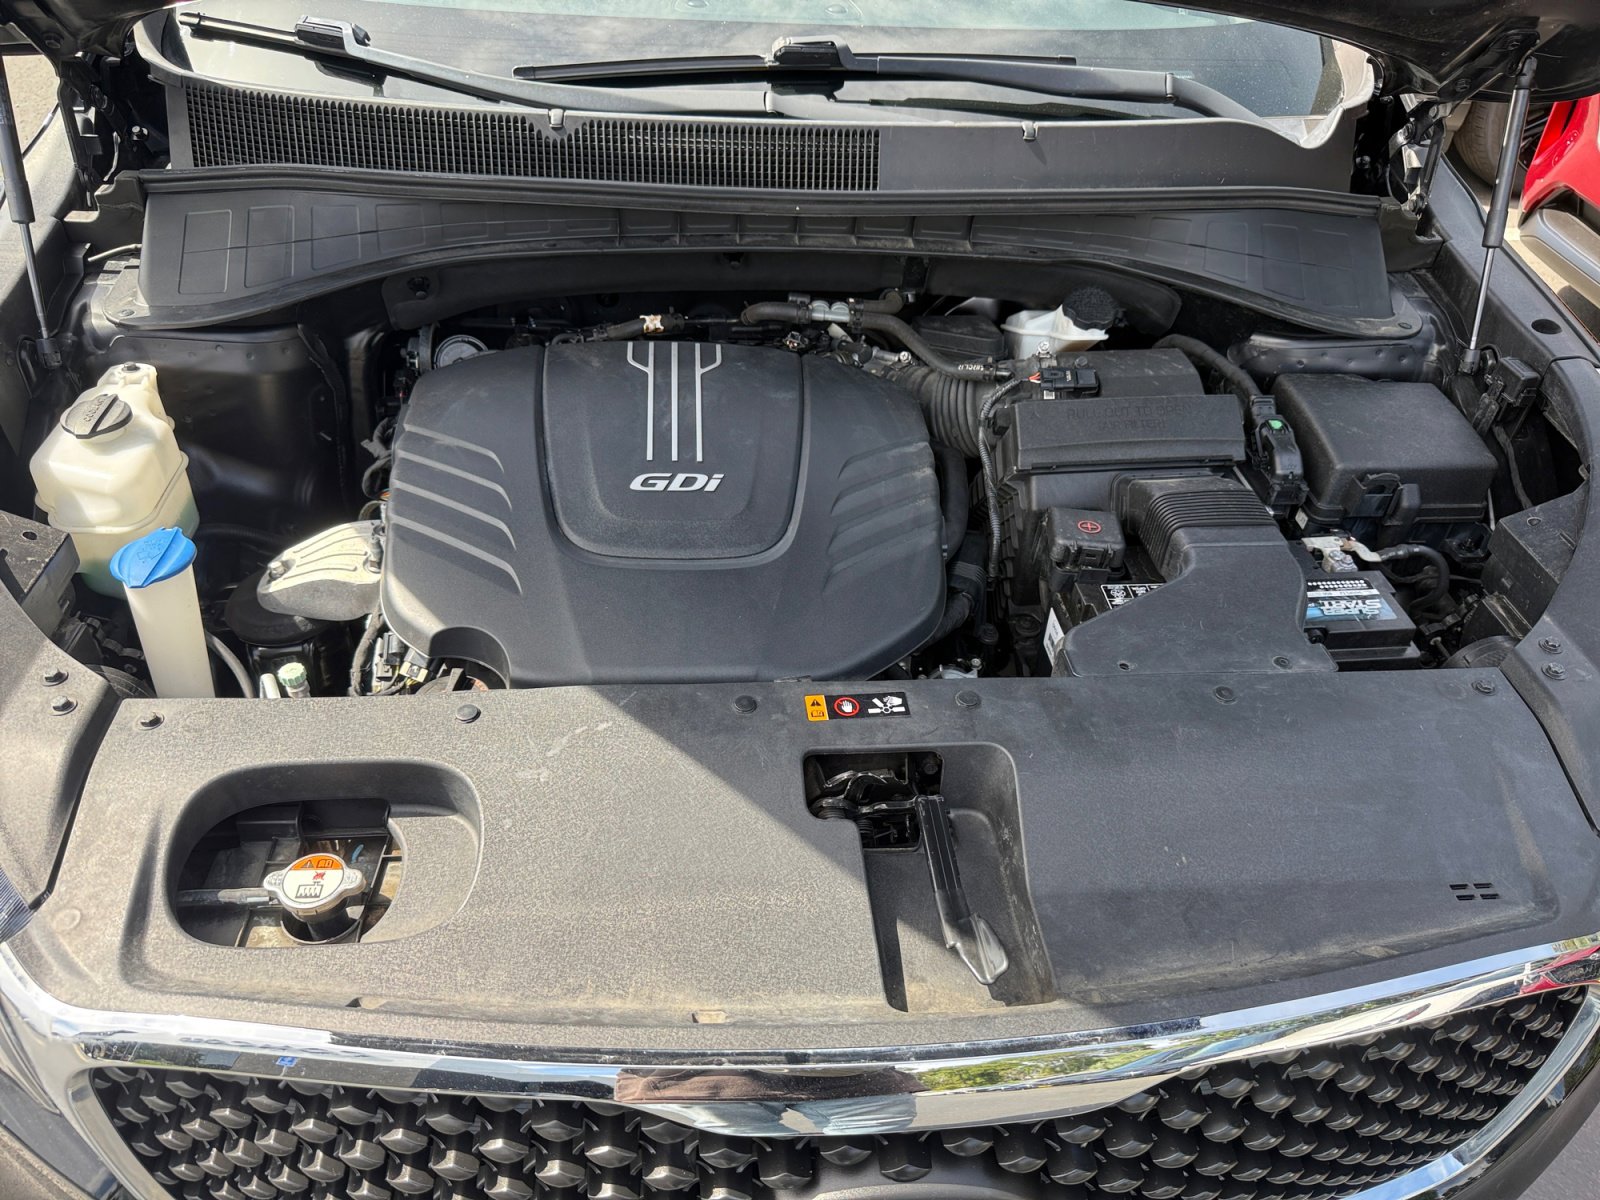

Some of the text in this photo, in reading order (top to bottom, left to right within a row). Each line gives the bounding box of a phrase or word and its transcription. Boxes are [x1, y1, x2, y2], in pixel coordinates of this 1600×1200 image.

[1104, 405, 1131, 418] OUT
[1136, 405, 1152, 417] TO
[629, 472, 725, 492] GDi
[1318, 599, 1381, 609] START
[1322, 606, 1380, 615] SUPER
